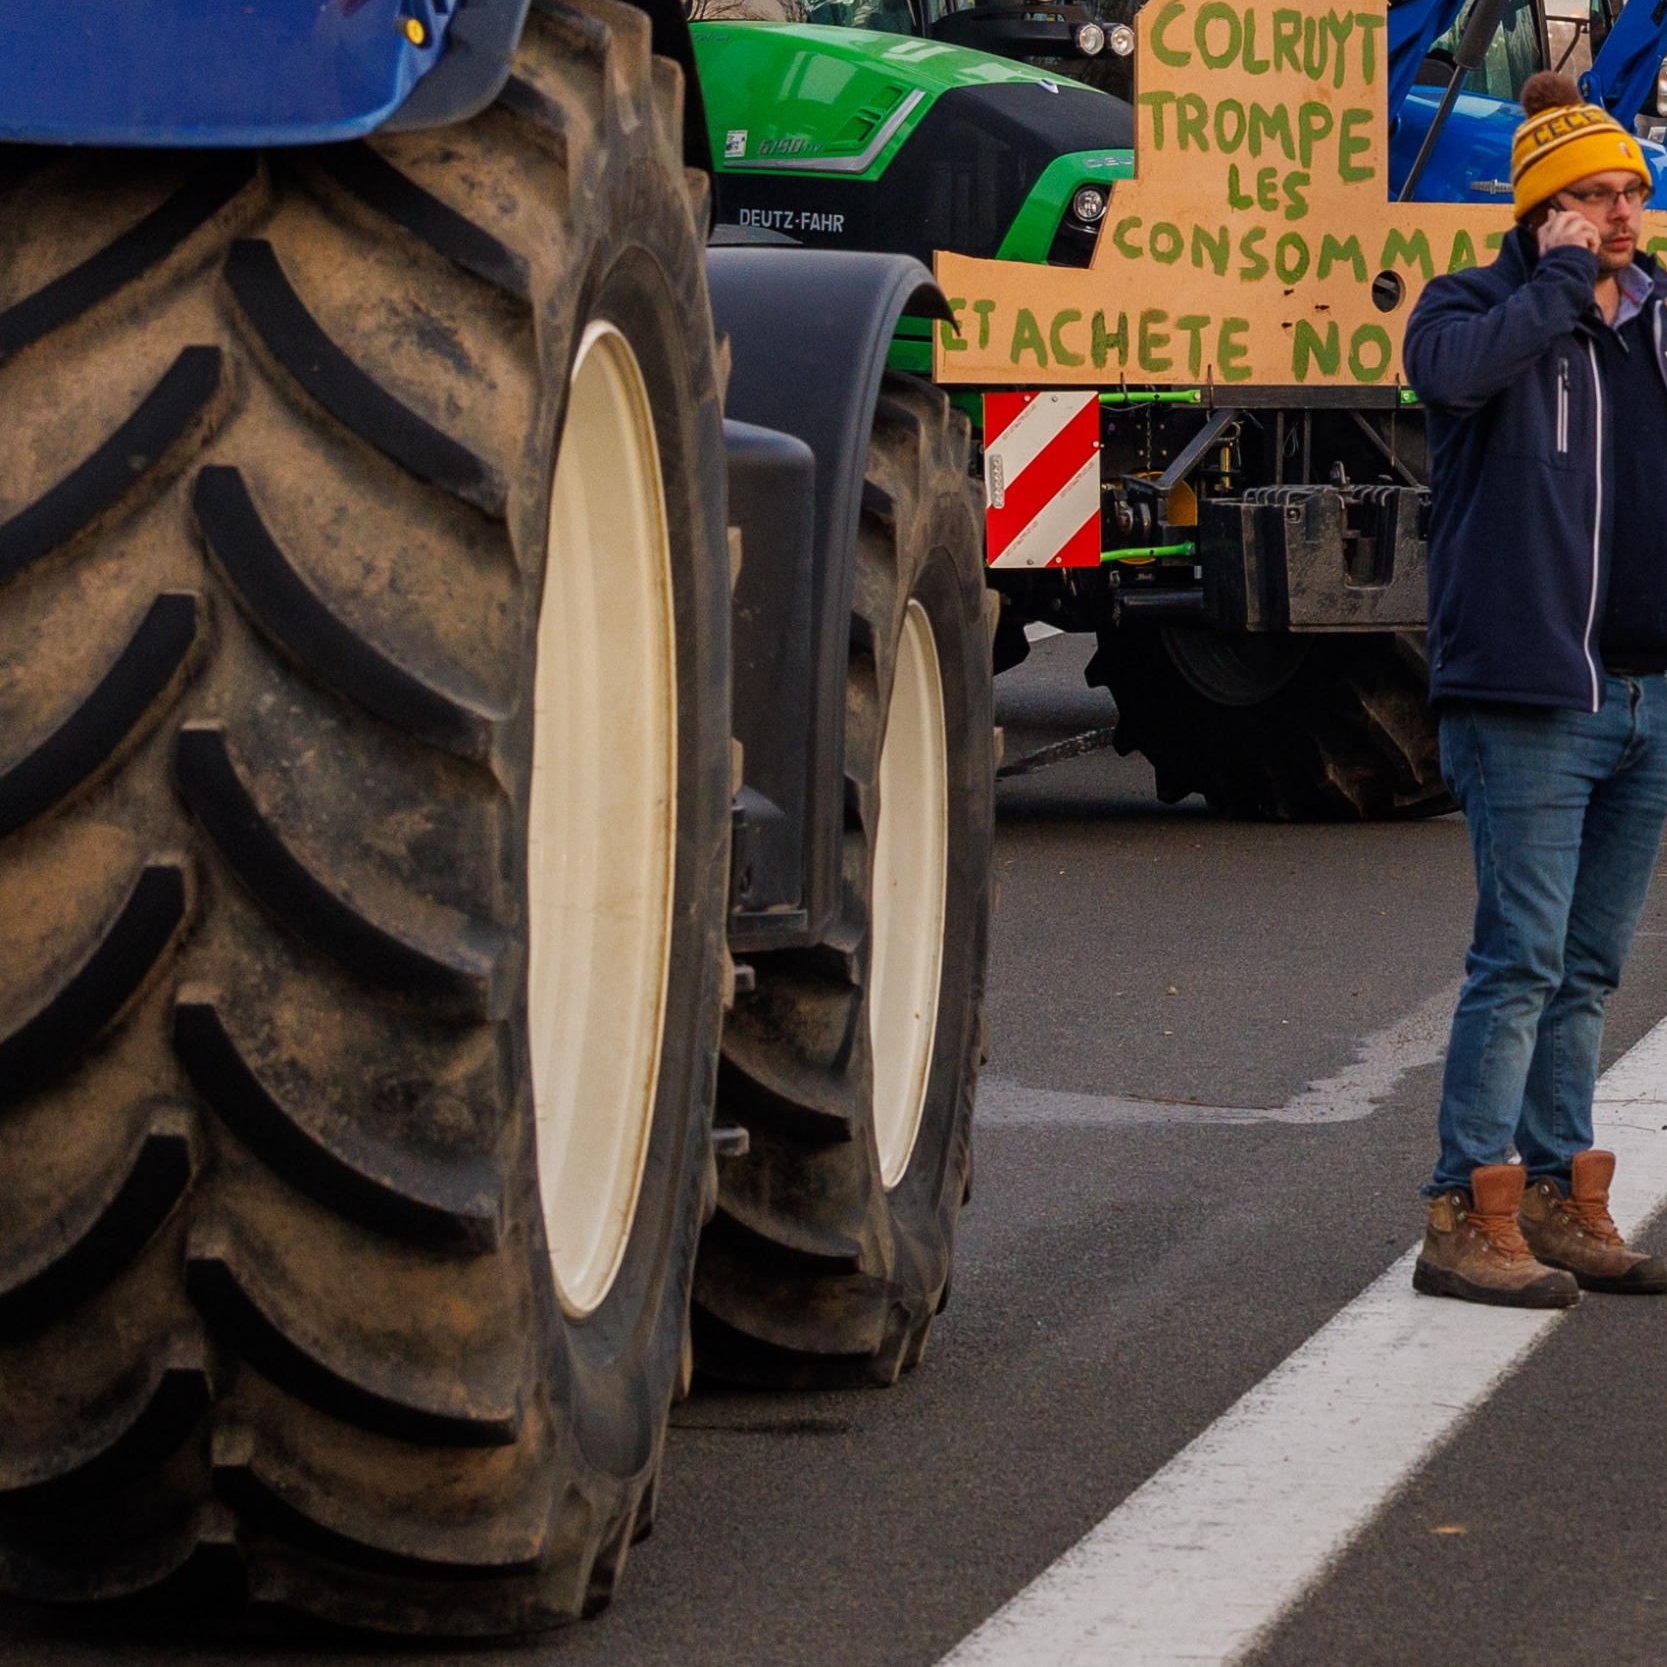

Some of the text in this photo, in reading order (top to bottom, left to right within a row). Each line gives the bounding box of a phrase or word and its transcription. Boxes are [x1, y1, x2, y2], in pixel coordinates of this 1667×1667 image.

[1151, 0, 1385, 89] COLRUYT
[1139, 91, 1376, 182] TROMPE
[1228, 163, 1311, 220] LES
[1010, 308, 1254, 382] ACHETE
